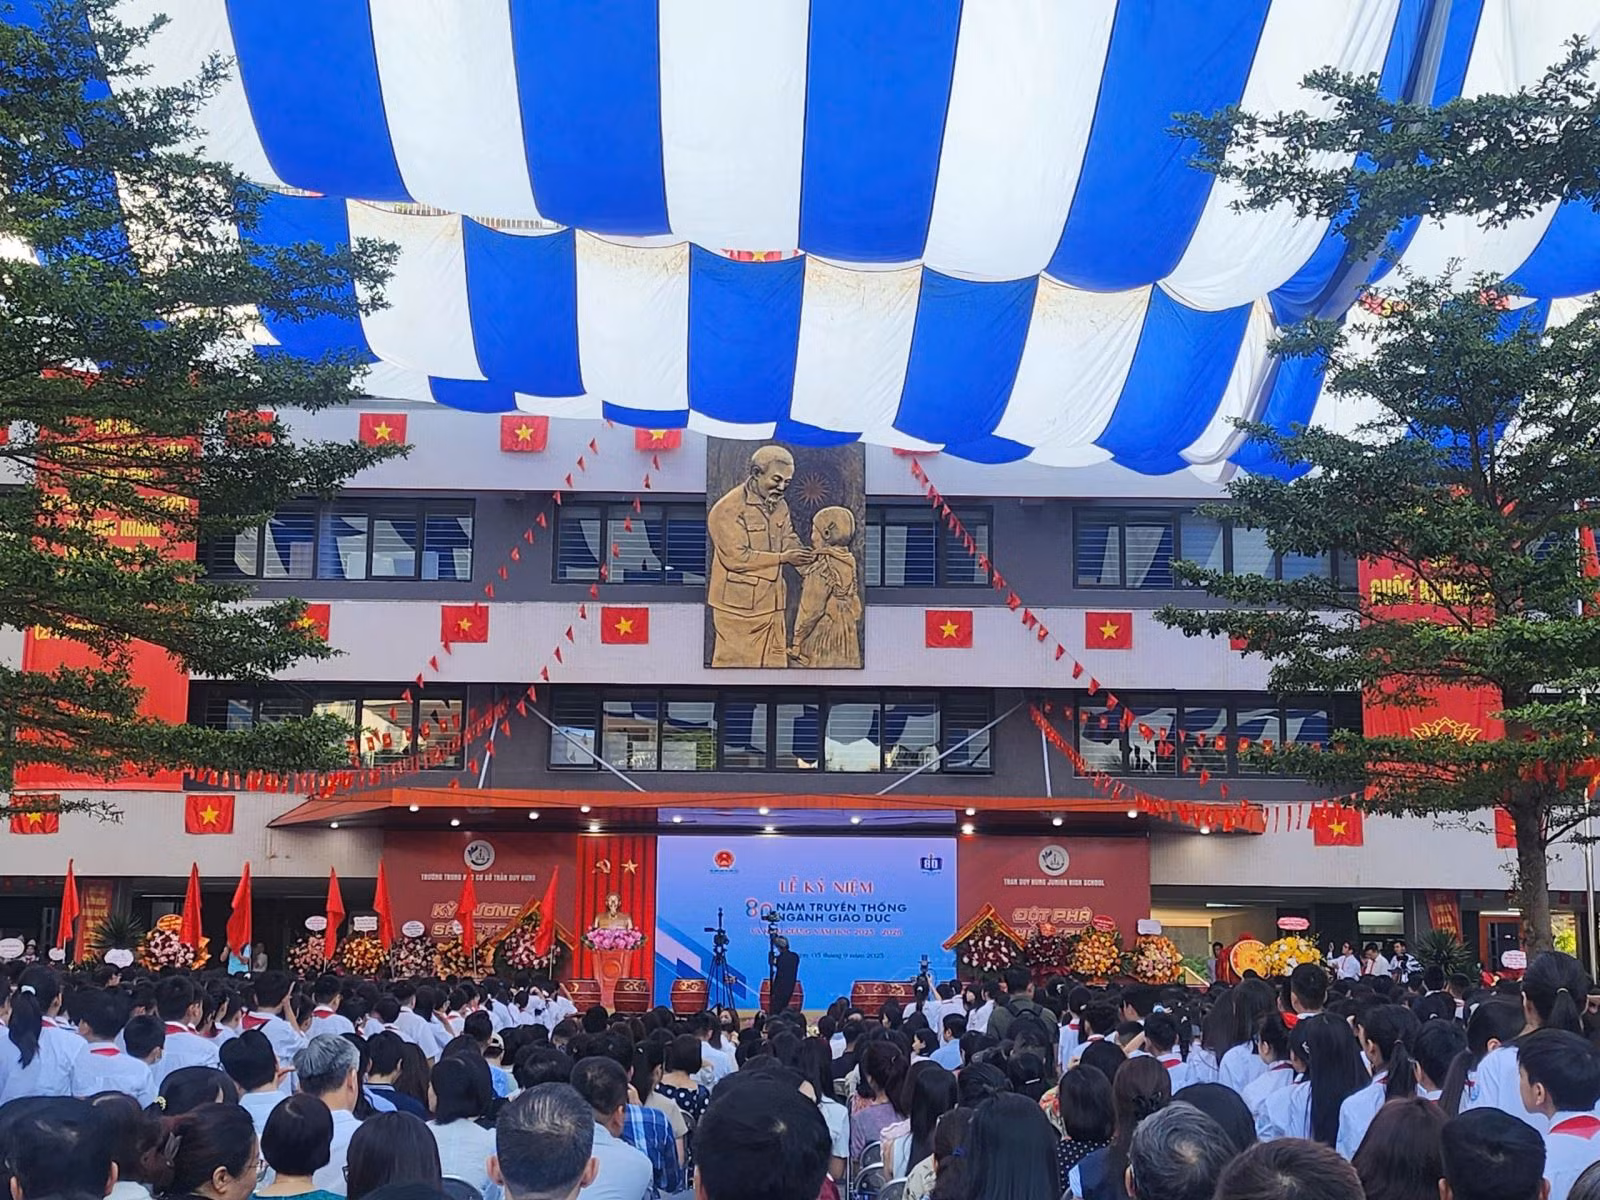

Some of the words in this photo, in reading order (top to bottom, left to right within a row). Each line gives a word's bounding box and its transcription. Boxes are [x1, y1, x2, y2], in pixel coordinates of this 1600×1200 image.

[779, 876, 798, 893] LỄ
[833, 878, 873, 896] NIỆM
[865, 913, 892, 924] DỤC
